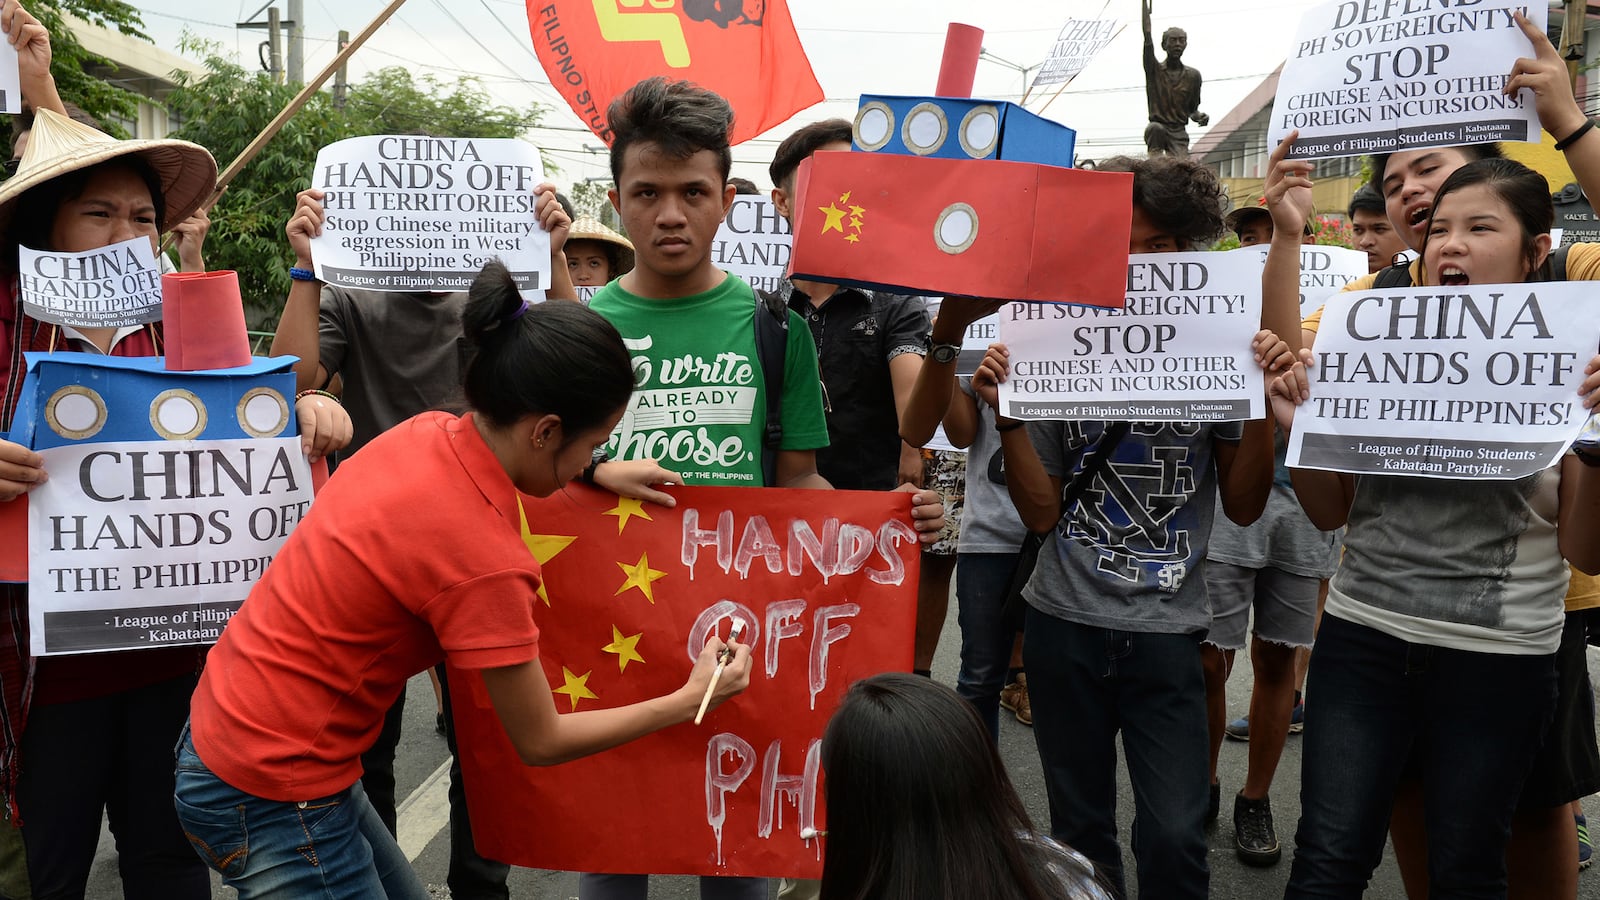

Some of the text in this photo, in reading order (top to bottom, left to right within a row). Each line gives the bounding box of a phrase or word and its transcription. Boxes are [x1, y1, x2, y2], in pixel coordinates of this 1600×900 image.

[1332, 0, 1484, 30] DEFE
[1058, 19, 1118, 41] CHINA
[1048, 41, 1086, 58] ANDS
[1297, 36, 1327, 58] PH
[1343, 44, 1449, 85] STOP
[1287, 87, 1370, 111] CHINESE
[1377, 81, 1426, 102] AND
[576, 89, 612, 142] STUD
[1281, 94, 1524, 130] FOREIGN INCURSIONS!
[1289, 131, 1455, 156] League of Filipino Students
[1465, 132, 1502, 142] Partylist
[378, 137, 482, 162] CHINA
[323, 162, 534, 191] HANDS OFF
[322, 191, 535, 214] PH TERRITORIES!
[326, 215, 534, 237] Stop Chinese military
[341, 234, 521, 252] aggression in West
[711, 240, 792, 267] HAND
[34, 246, 145, 281] CHINA
[360, 253, 456, 270] Philippine
[20, 269, 158, 299] HANDS OFF
[336, 273, 376, 286] League
[378, 275, 390, 286] of
[393, 276, 434, 289] Filipino
[1127, 262, 1210, 292] END
[24, 289, 162, 312] THE PHILIPPINES
[1011, 302, 1045, 321] PH
[45, 307, 74, 318] League
[87, 311, 118, 320] Filipino
[120, 307, 150, 318] Students
[64, 317, 102, 327] Kabataan
[104, 318, 137, 327] Partylist
[1346, 292, 1554, 341] CHINA
[968, 323, 996, 339] HE
[1073, 324, 1177, 356] STOP
[659, 352, 754, 385] write
[1014, 356, 1238, 376] CHINESE AND OTHER
[1317, 351, 1577, 386] HANDS OFF
[1012, 375, 1246, 393] FOREIGN INCURSIONS!
[637, 391, 738, 409] ALREADY
[1020, 405, 1181, 418] League of Filipino Students
[1313, 397, 1572, 426] THE PHILIPPINES!
[669, 410, 696, 424] TO
[1190, 411, 1225, 421] Partylist
[1358, 442, 1402, 456] League
[1405, 444, 1420, 456] of
[1423, 445, 1473, 461] Filipino
[1477, 447, 1536, 460] Students
[79, 446, 299, 502] CHINA
[682, 472, 754, 481] OF THE PHILIPPINES
[1383, 458, 1442, 473] Kabataan
[1447, 461, 1503, 476] Partylist
[50, 509, 232, 551] HANDS
[681, 508, 917, 586] HANDS
[48, 555, 272, 593] THE PHILIPPI
[114, 614, 168, 629] League
[172, 611, 188, 624] of
[193, 608, 238, 624] Filipi
[149, 628, 219, 642] Kabataan
[687, 599, 860, 708] OFF
[705, 732, 823, 860] PH
